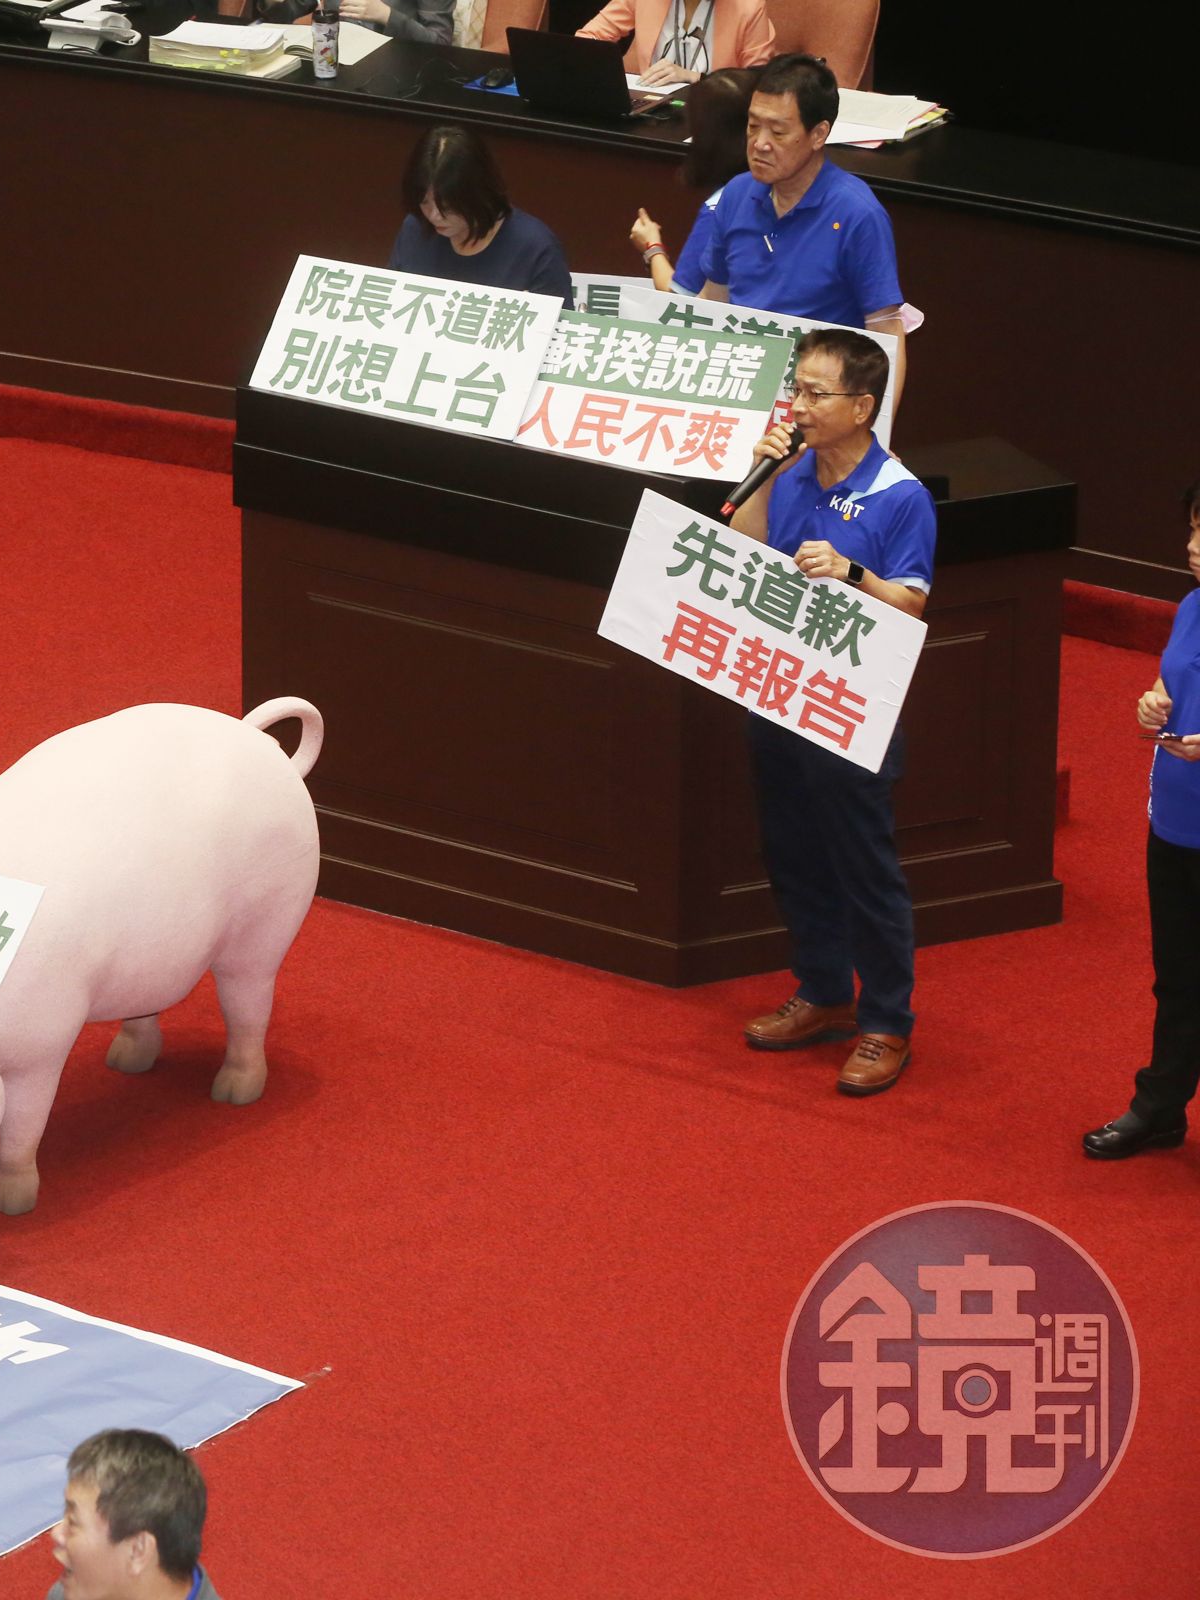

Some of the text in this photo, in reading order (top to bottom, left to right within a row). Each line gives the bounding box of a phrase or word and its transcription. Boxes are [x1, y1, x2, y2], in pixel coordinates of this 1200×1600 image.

[295, 266, 538, 353] 院長不道歉
[269, 329, 507, 428] 別想上台
[541, 318, 766, 402] 蘇揆說謊
[517, 386, 739, 472] 人民不爽
[829, 494, 865, 518] KMT
[667, 521, 877, 667] 先道歉
[662, 602, 867, 751] 再報告
